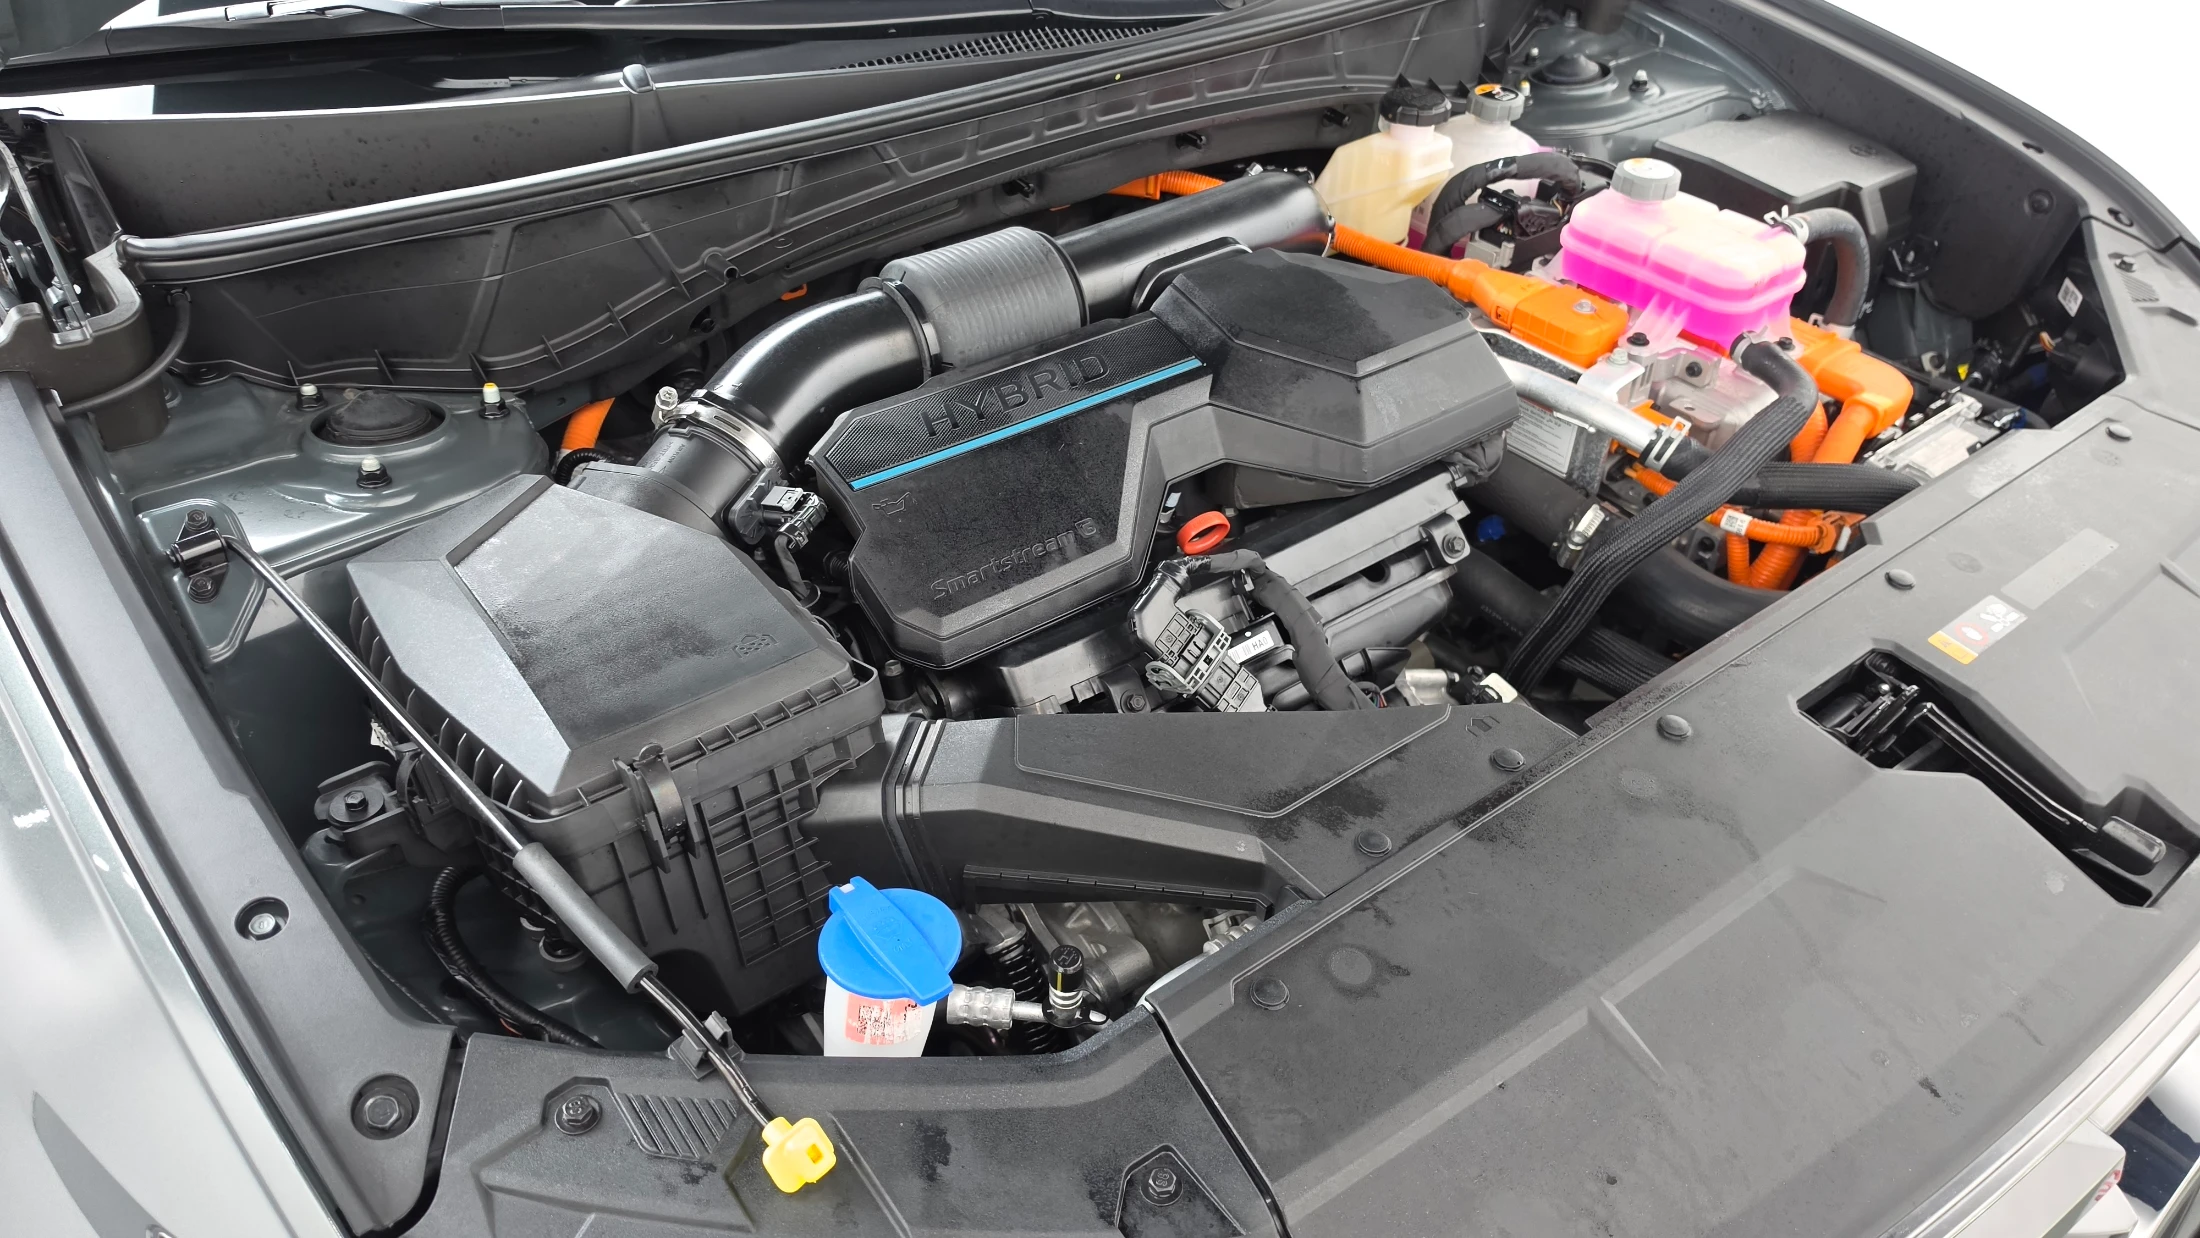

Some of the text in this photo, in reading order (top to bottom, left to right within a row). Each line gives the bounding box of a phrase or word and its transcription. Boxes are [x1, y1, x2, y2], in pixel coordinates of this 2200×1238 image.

[919, 353, 1109, 438] HYBRID
[930, 517, 1097, 600] Smartstream G
